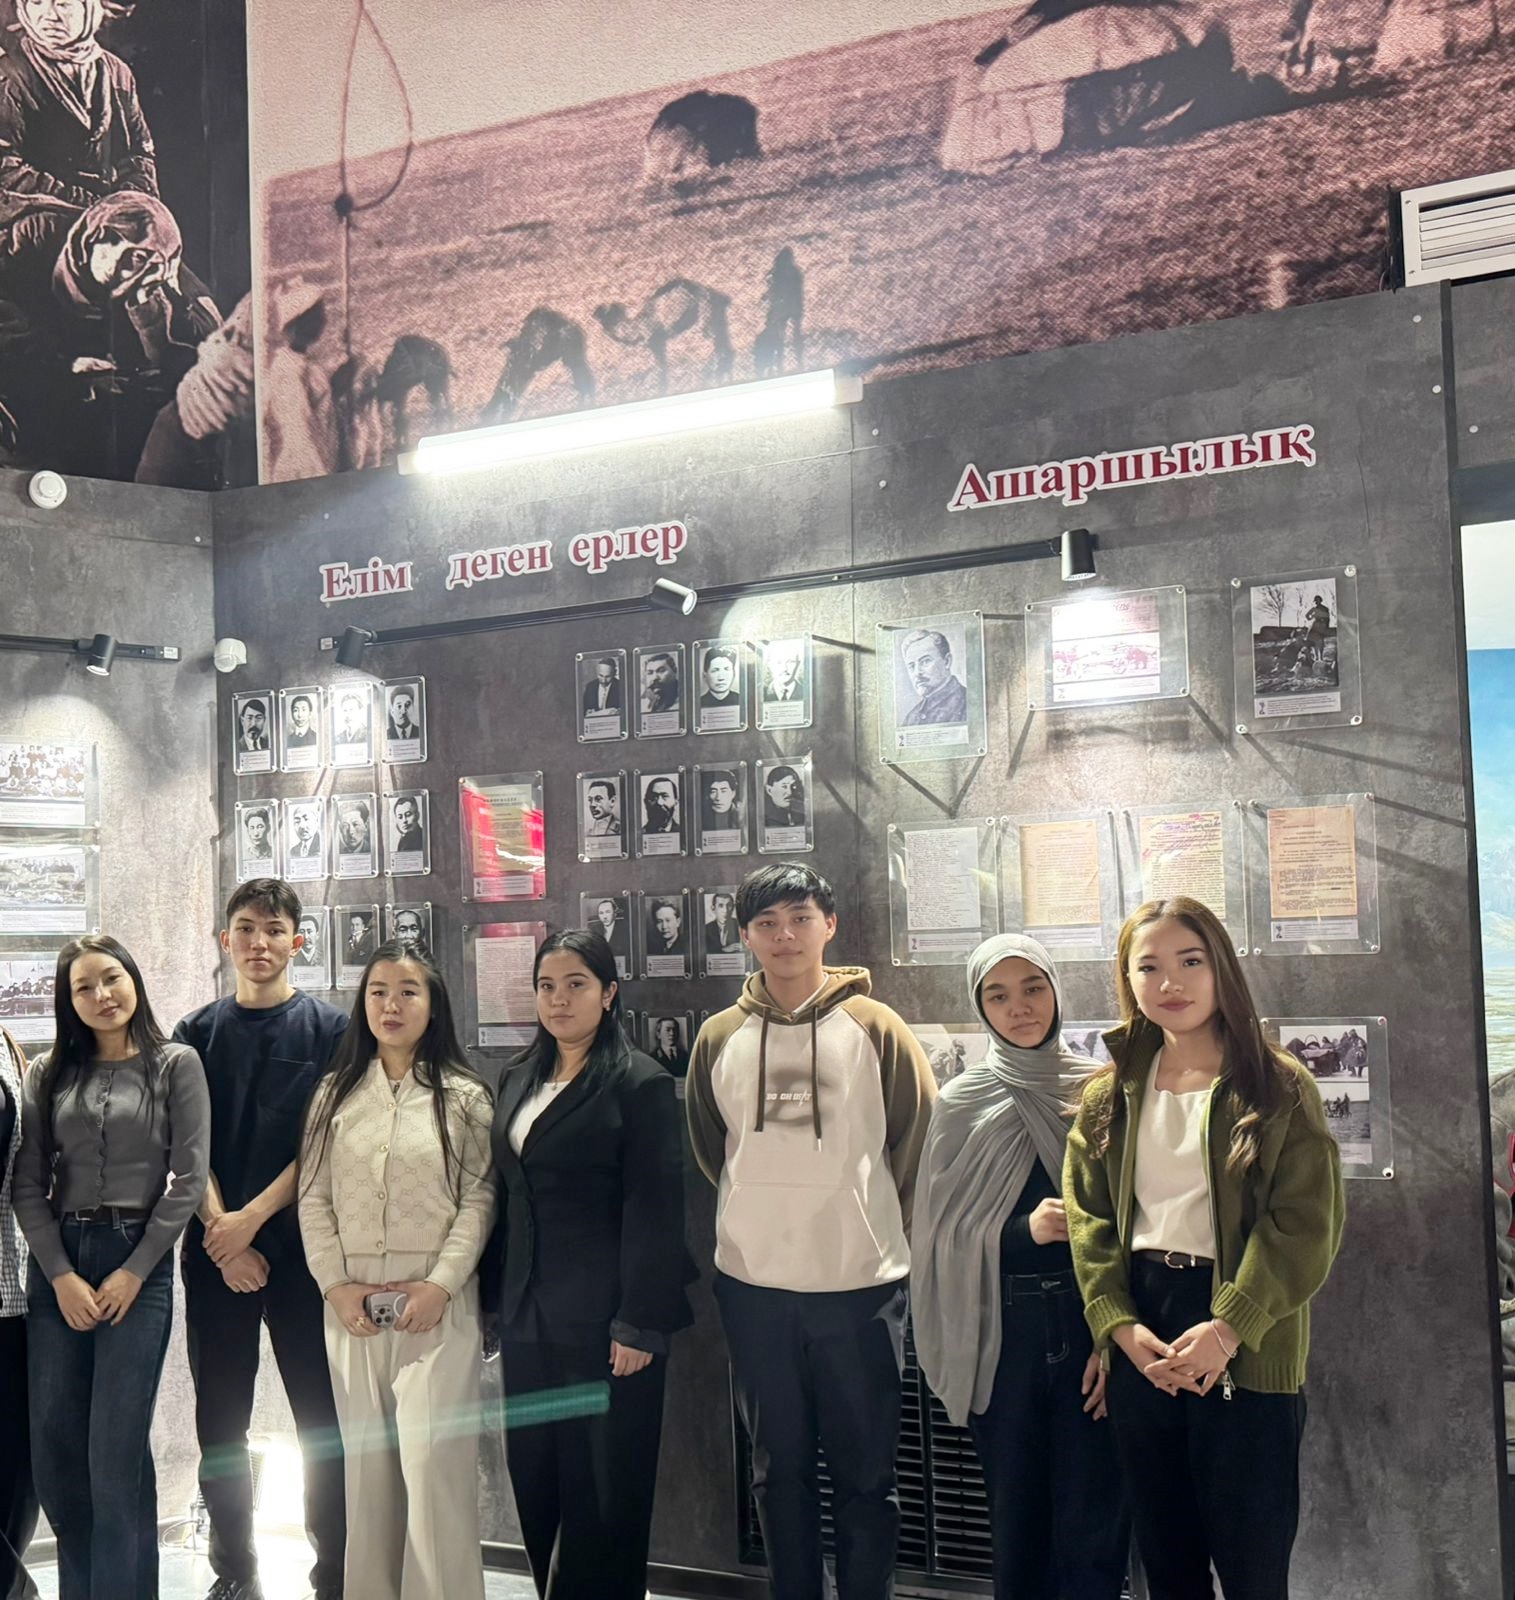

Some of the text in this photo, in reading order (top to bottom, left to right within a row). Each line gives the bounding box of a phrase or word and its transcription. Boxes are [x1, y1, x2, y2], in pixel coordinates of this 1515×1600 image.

[951, 427, 1313, 507] Ашаршылық
[322, 523, 685, 600] Елім деген ерлер
